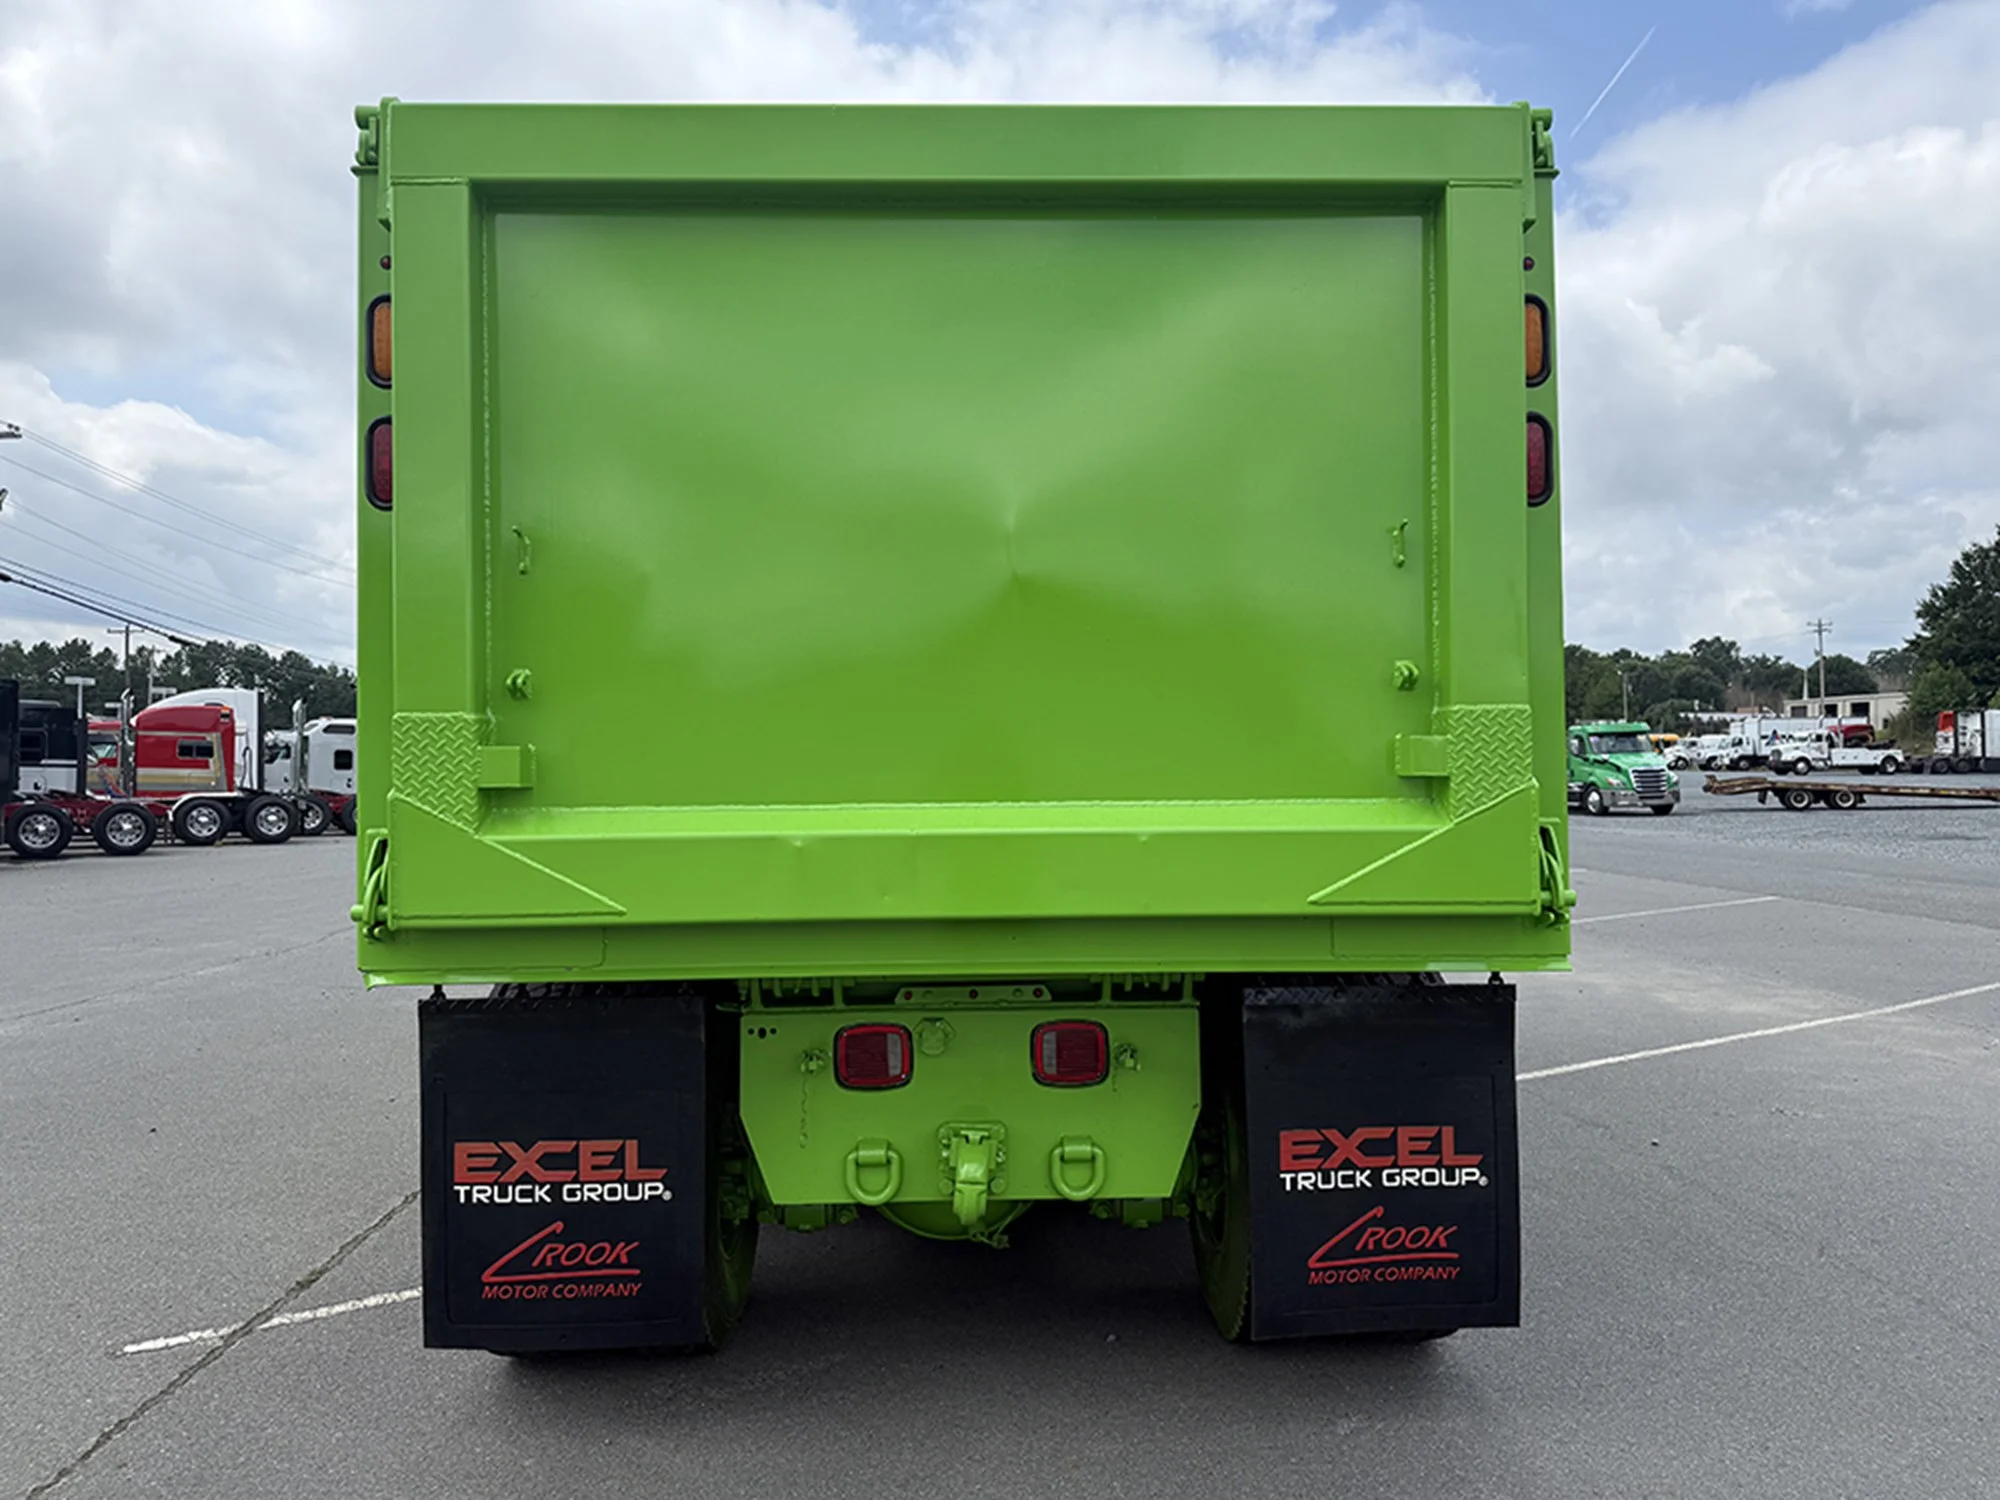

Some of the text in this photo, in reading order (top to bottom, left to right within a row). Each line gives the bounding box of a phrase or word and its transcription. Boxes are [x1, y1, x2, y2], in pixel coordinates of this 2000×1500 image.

[453, 1139, 668, 1183] EXCEL
[1279, 1126, 1484, 1171] EXCEL
[453, 1184, 551, 1203] TRUCK
[1280, 1169, 1372, 1190] TRUCK
[481, 1221, 640, 1282] CROOK
[1308, 1206, 1460, 1268] CROOK
[481, 1283, 642, 1299] MOTOR COMPANY
[1308, 1267, 1461, 1285] MOTOR COMPANY
